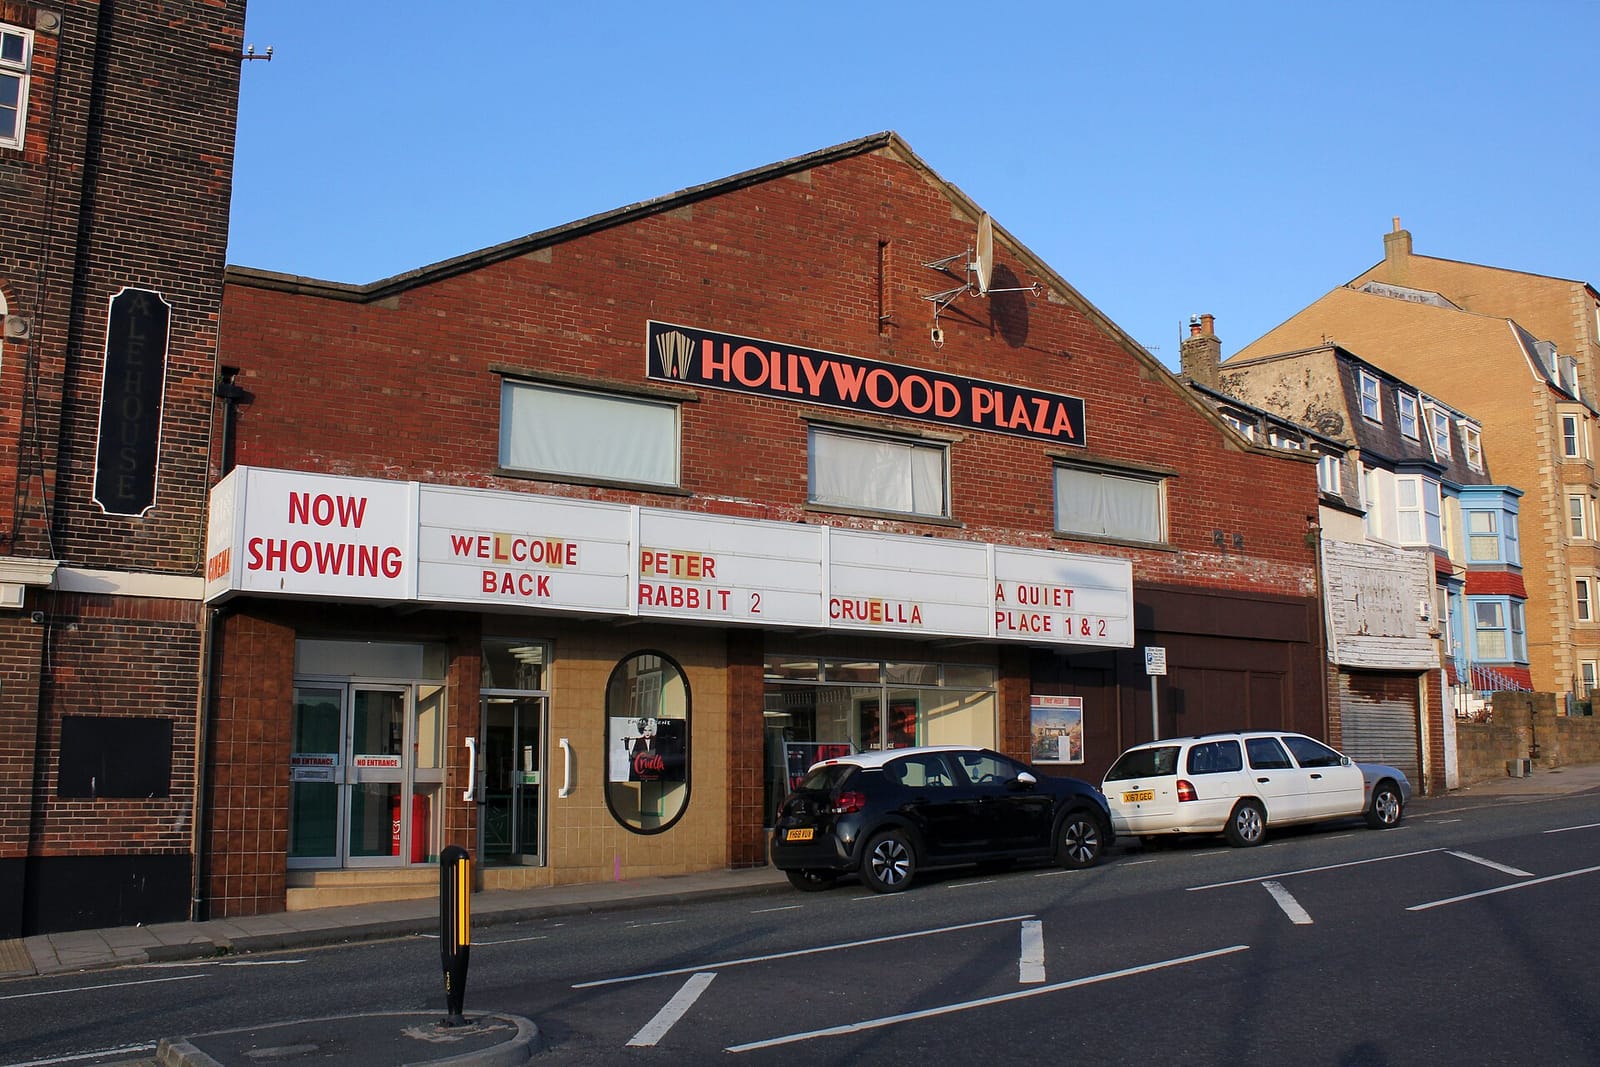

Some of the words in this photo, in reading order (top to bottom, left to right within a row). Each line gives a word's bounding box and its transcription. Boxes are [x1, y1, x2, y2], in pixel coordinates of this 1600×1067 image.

[118, 293, 151, 498] ALEHOUSE
[702, 339, 962, 418] HOLLYWOOD
[972, 387, 1075, 438] PLAZA
[288, 491, 368, 529] NOW
[247, 536, 403, 579] SHOWING
[450, 534, 578, 566] WELCOME
[640, 550, 716, 578] PETER
[482, 570, 551, 598] BACK
[639, 583, 731, 611] RABBIT
[750, 592, 761, 614] 2
[995, 582, 1006, 602] A
[1017, 584, 1074, 608] QUIET
[829, 598, 922, 625] CRUELLA
[995, 611, 1052, 633] PLACE
[1064, 616, 1073, 635] 1
[1080, 617, 1092, 637] &
[1097, 619, 1106, 637] 2
[633, 751, 665, 775] Cruella
